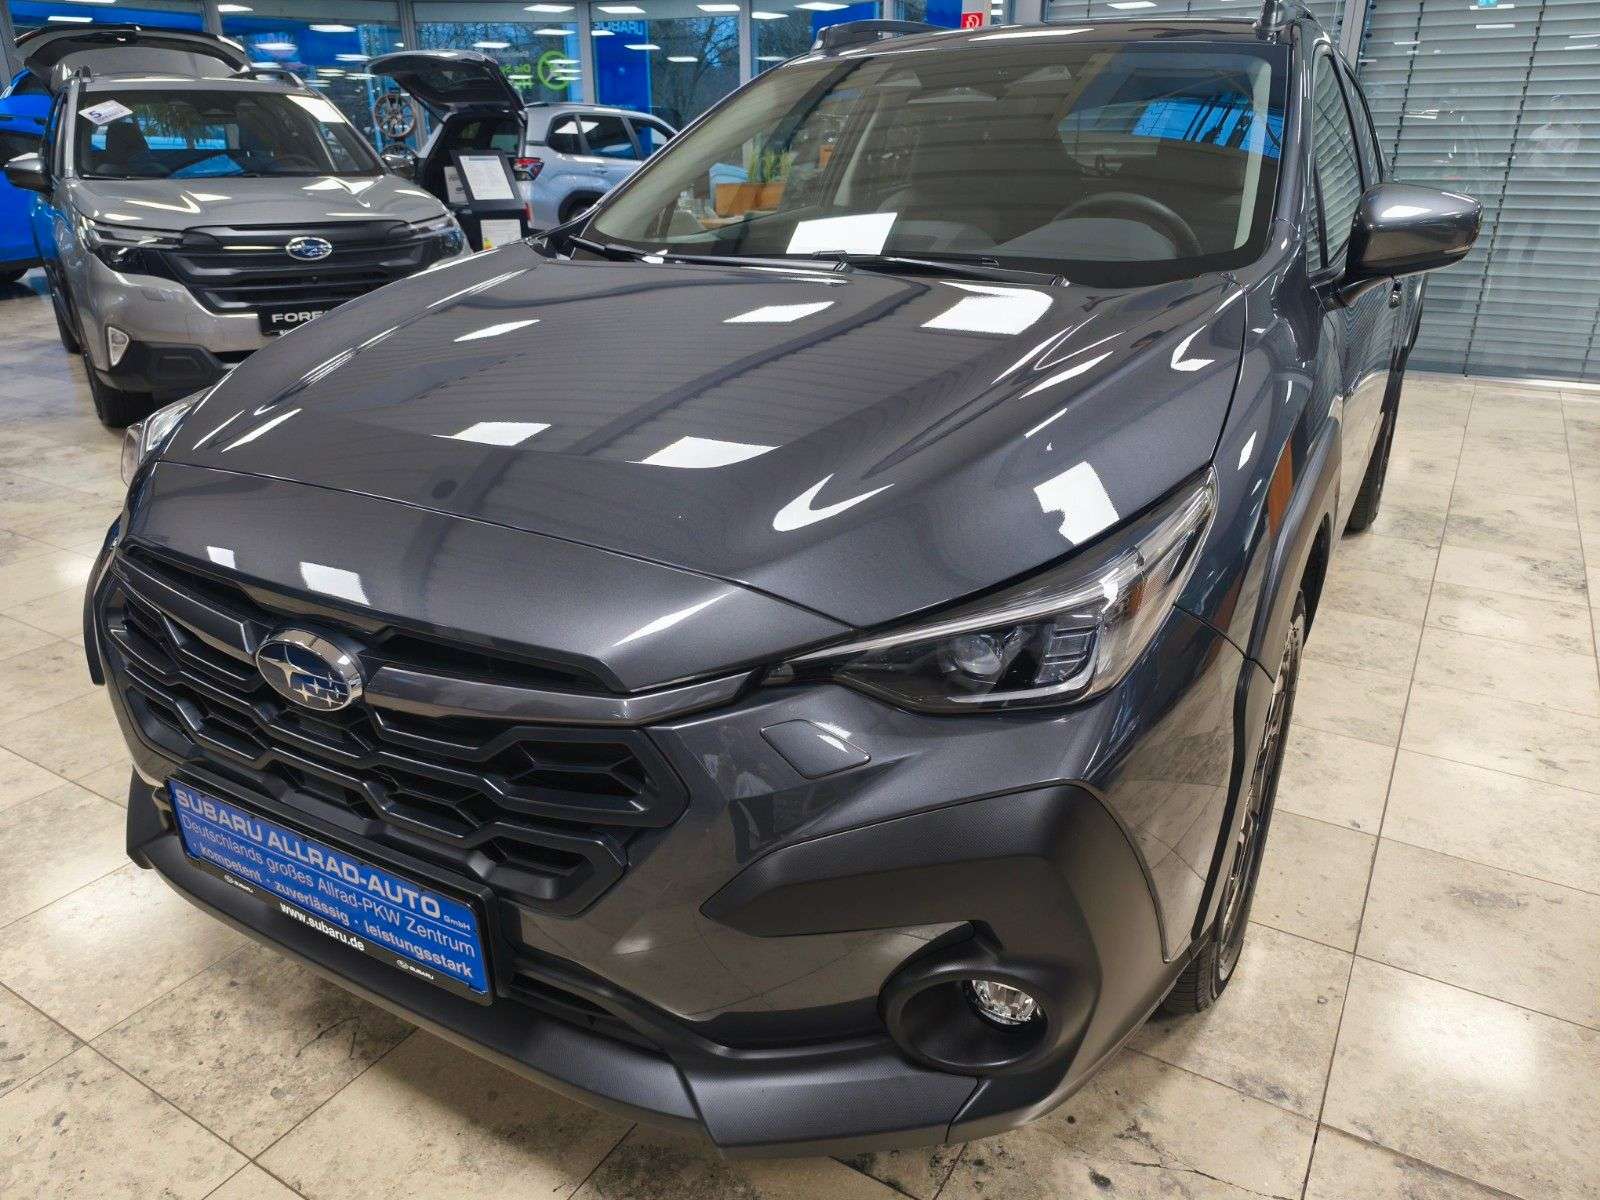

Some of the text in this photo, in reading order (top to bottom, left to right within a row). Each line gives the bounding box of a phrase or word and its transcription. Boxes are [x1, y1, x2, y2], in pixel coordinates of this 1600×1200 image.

[175, 788, 471, 931] SUBARU ALLRAD-AUTO GmbH
[181, 814, 475, 958] Deutschlands großes Allrad-PKW Zentrum
[200, 842, 473, 978] kompetent zuverlässig leistungsstark
[279, 902, 365, 951] www.subaru.de
